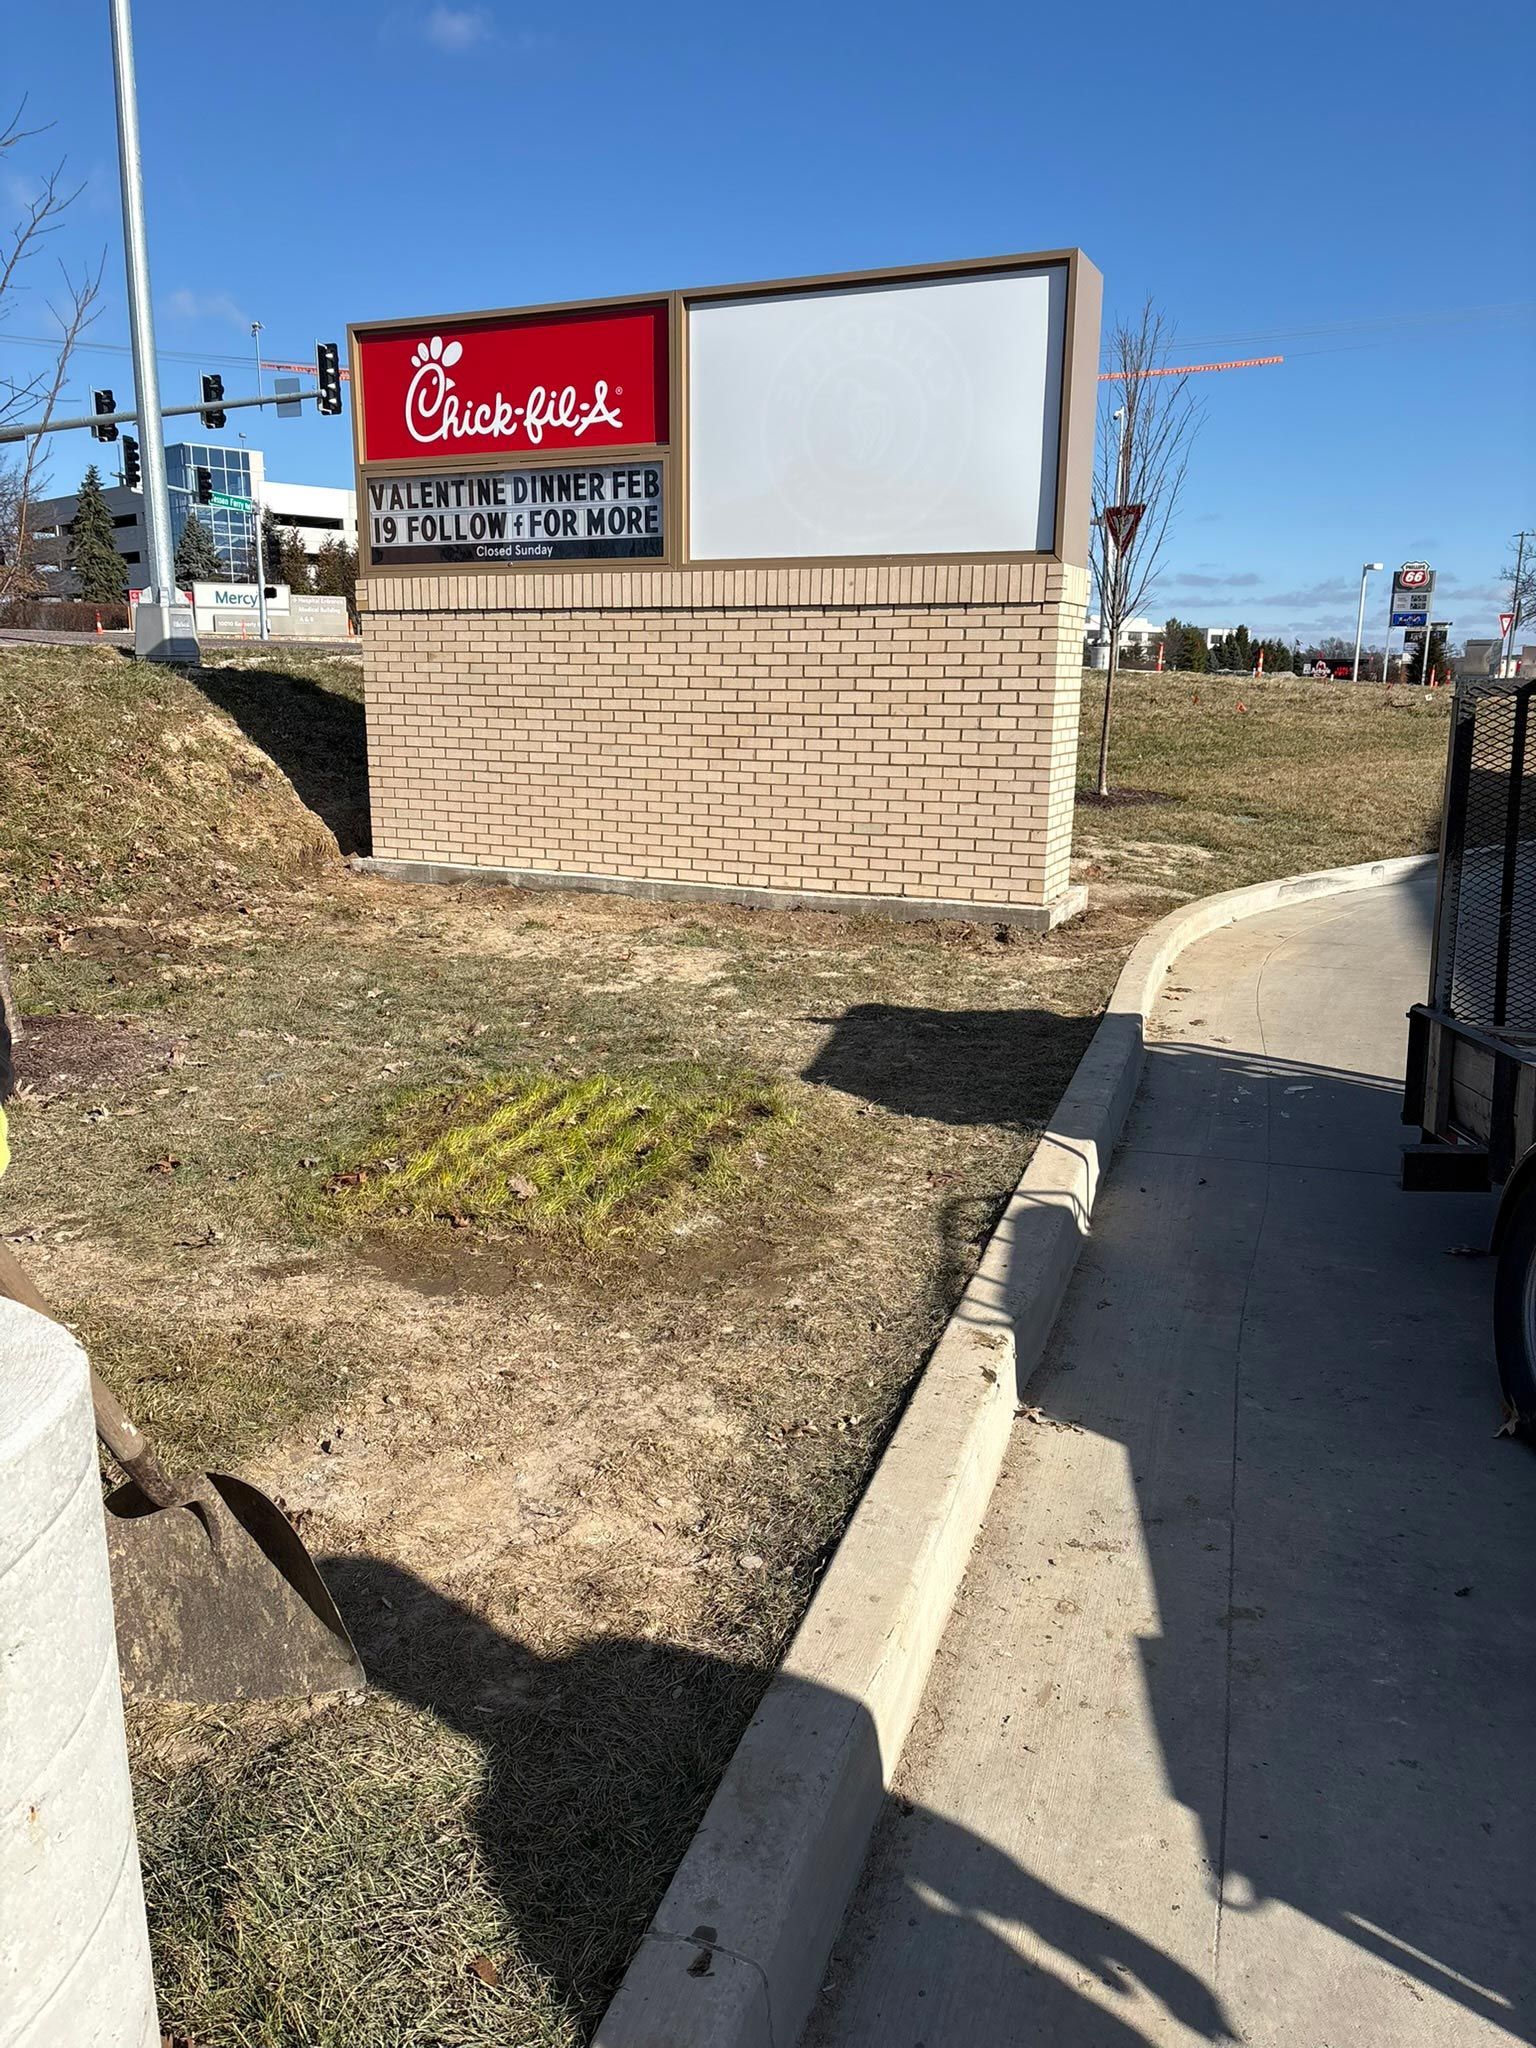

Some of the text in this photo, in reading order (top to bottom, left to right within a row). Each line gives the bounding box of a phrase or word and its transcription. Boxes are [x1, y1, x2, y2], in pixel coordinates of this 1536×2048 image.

[405, 362, 623, 444] Chick-fil-A
[370, 469, 660, 510] VALENTINE DINNER FEB
[374, 516, 397, 544] 19
[408, 512, 507, 542] FOLLOW
[529, 508, 578, 537] FOR
[587, 505, 659, 536] MORE
[476, 544, 553, 558] Closed Sunday
[1405, 572, 1424, 582] 66
[215, 591, 258, 607] Mercy
